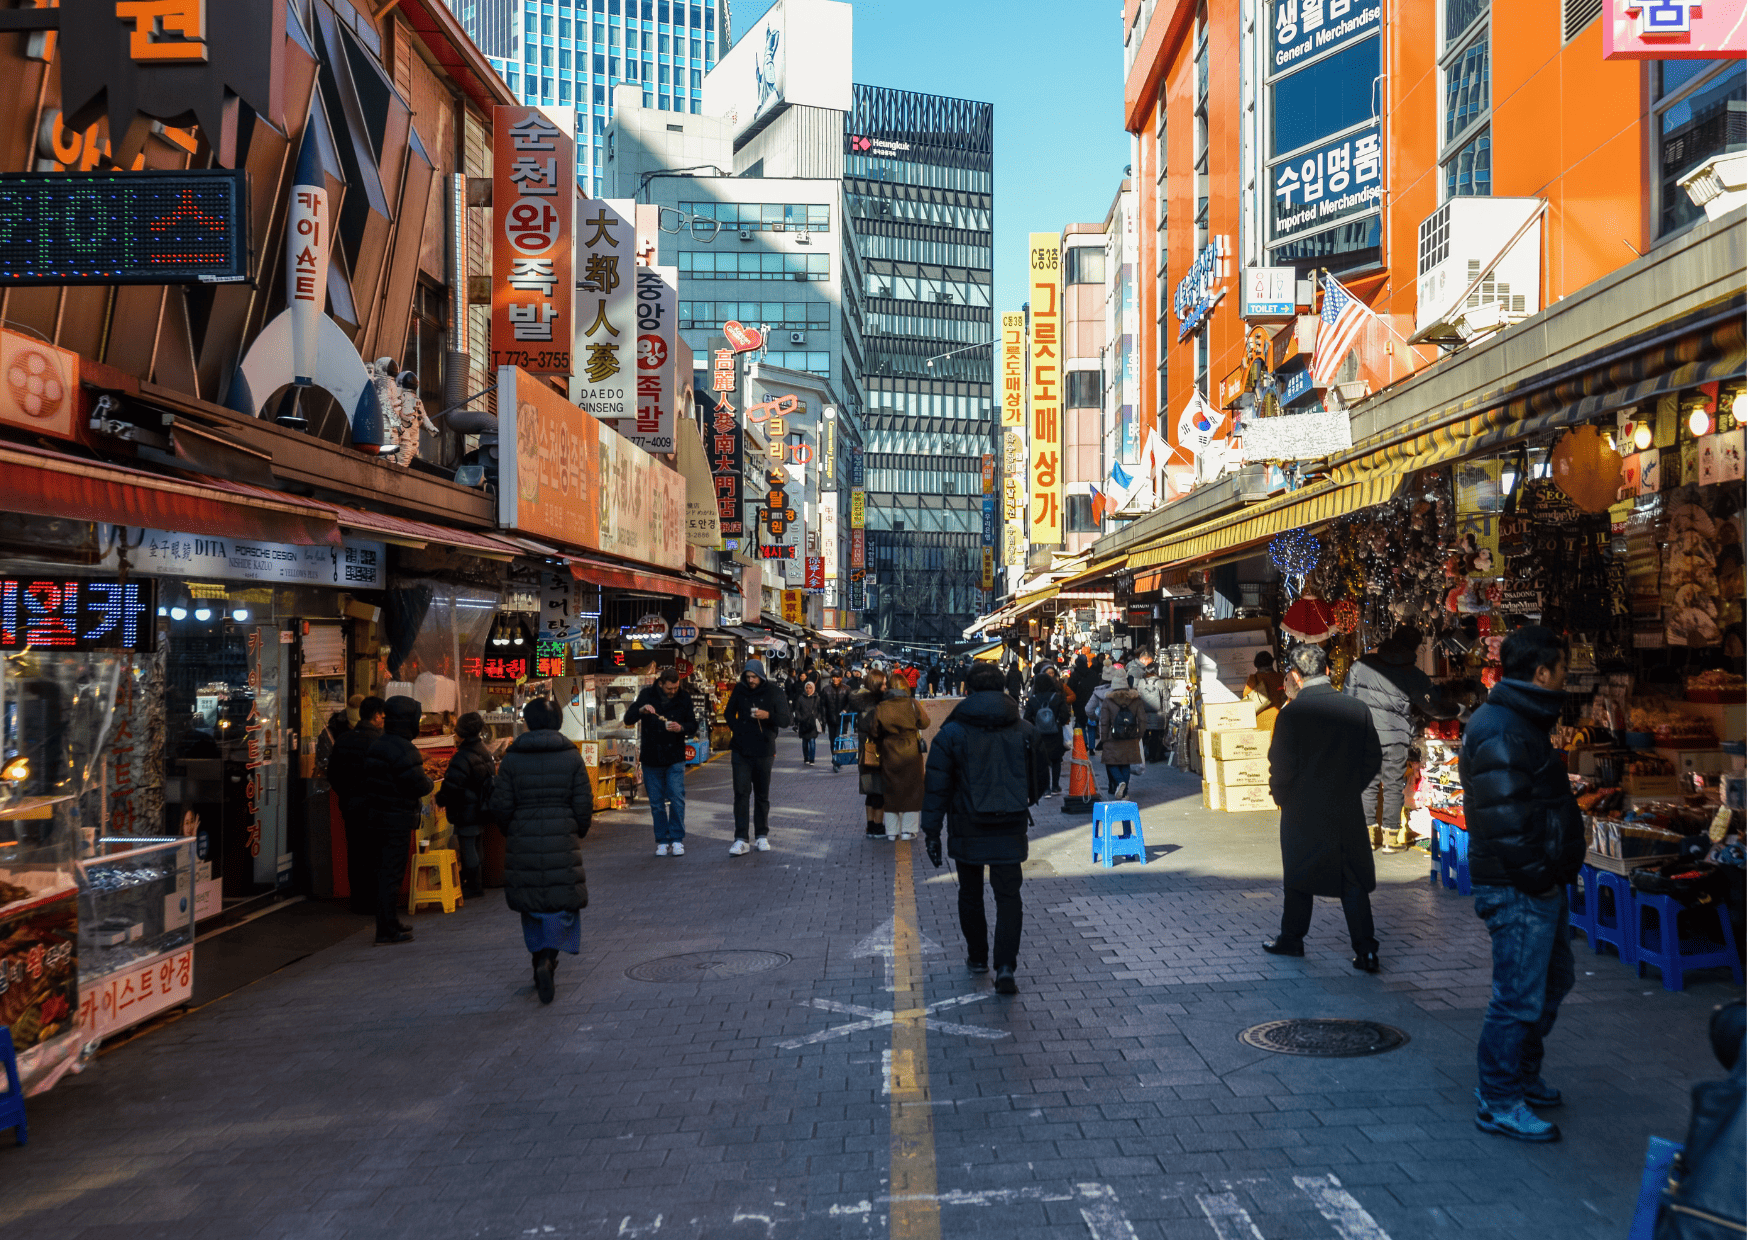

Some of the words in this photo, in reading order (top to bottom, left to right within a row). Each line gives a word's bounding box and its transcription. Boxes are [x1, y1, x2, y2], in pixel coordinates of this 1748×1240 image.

[1276, 36, 1313, 65] General
[1316, 6, 1380, 47] Merchandise
[873, 139, 910, 150] Heungkuk
[1276, 134, 1380, 210] 수입명품
[1276, 203, 1317, 232] Imported
[1319, 185, 1380, 216] Merchandise
[507, 112, 559, 342] 순천왕족발
[294, 192, 322, 301] 카이스트
[1031, 249, 1059, 271] C동3층
[1250, 302, 1279, 313] TOILET
[1003, 316, 1023, 327] C동3층
[636, 273, 669, 433] 중앙왕족발
[1005, 330, 1021, 422] 그릇도매상가
[581, 389, 624, 400] DAEDO
[579, 403, 624, 414] GINSENG
[1033, 283, 1058, 528] 그릇도매상가
[828, 421, 836, 455] Community
[770, 418, 784, 508] 크리스탈
[685, 518, 716, 530] 도안경
[771, 521, 783, 533] 원
[194, 538, 227, 559] DITA
[235, 545, 270, 559] PORSCHE
[272, 550, 297, 562] DESIGN
[228, 556, 252, 570] NISHIDE
[285, 567, 307, 578] YELLOWS
[547, 570, 570, 638] 추어탕
[539, 657, 562, 676] 족발
[684, 750, 696, 758] ALE
[80, 970, 154, 1030] 카이스트
[159, 951, 191, 995] 안경
